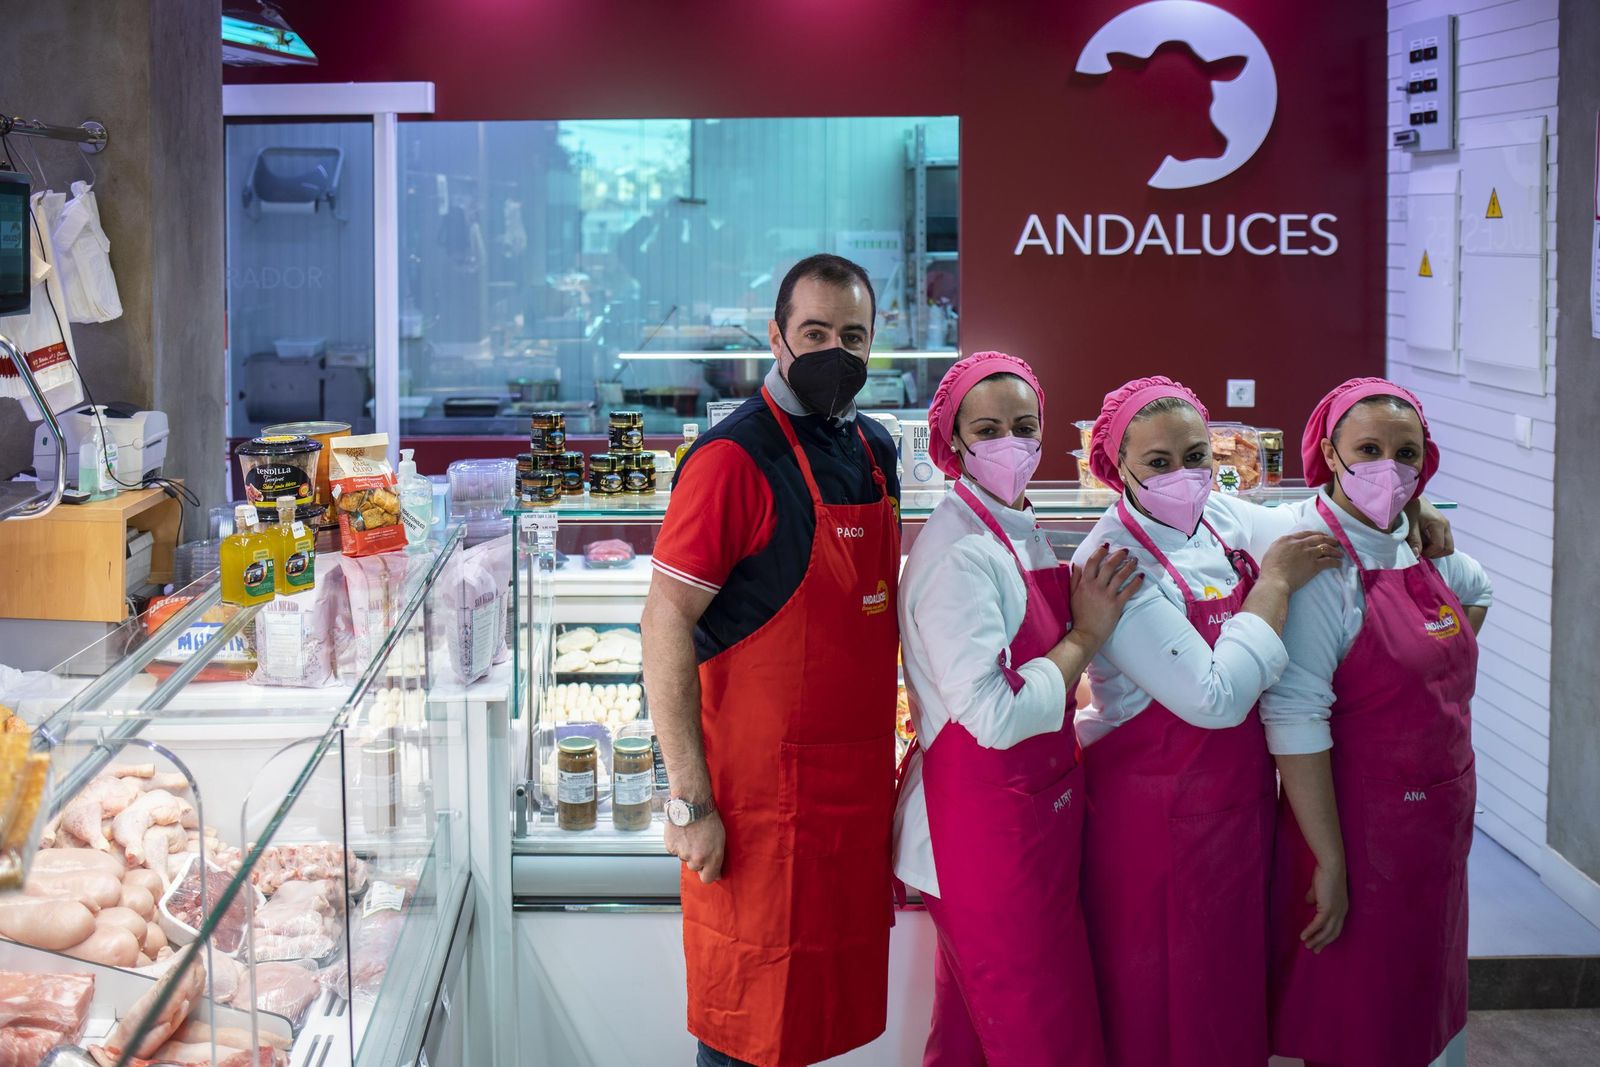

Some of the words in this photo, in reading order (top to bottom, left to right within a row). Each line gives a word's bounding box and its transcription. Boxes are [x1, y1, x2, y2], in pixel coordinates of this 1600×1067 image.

[1013, 212, 1339, 256] ANDALUCES
[913, 427, 930, 438] FLOR
[836, 527, 865, 538] PACO
[1403, 791, 1427, 802] ANA
